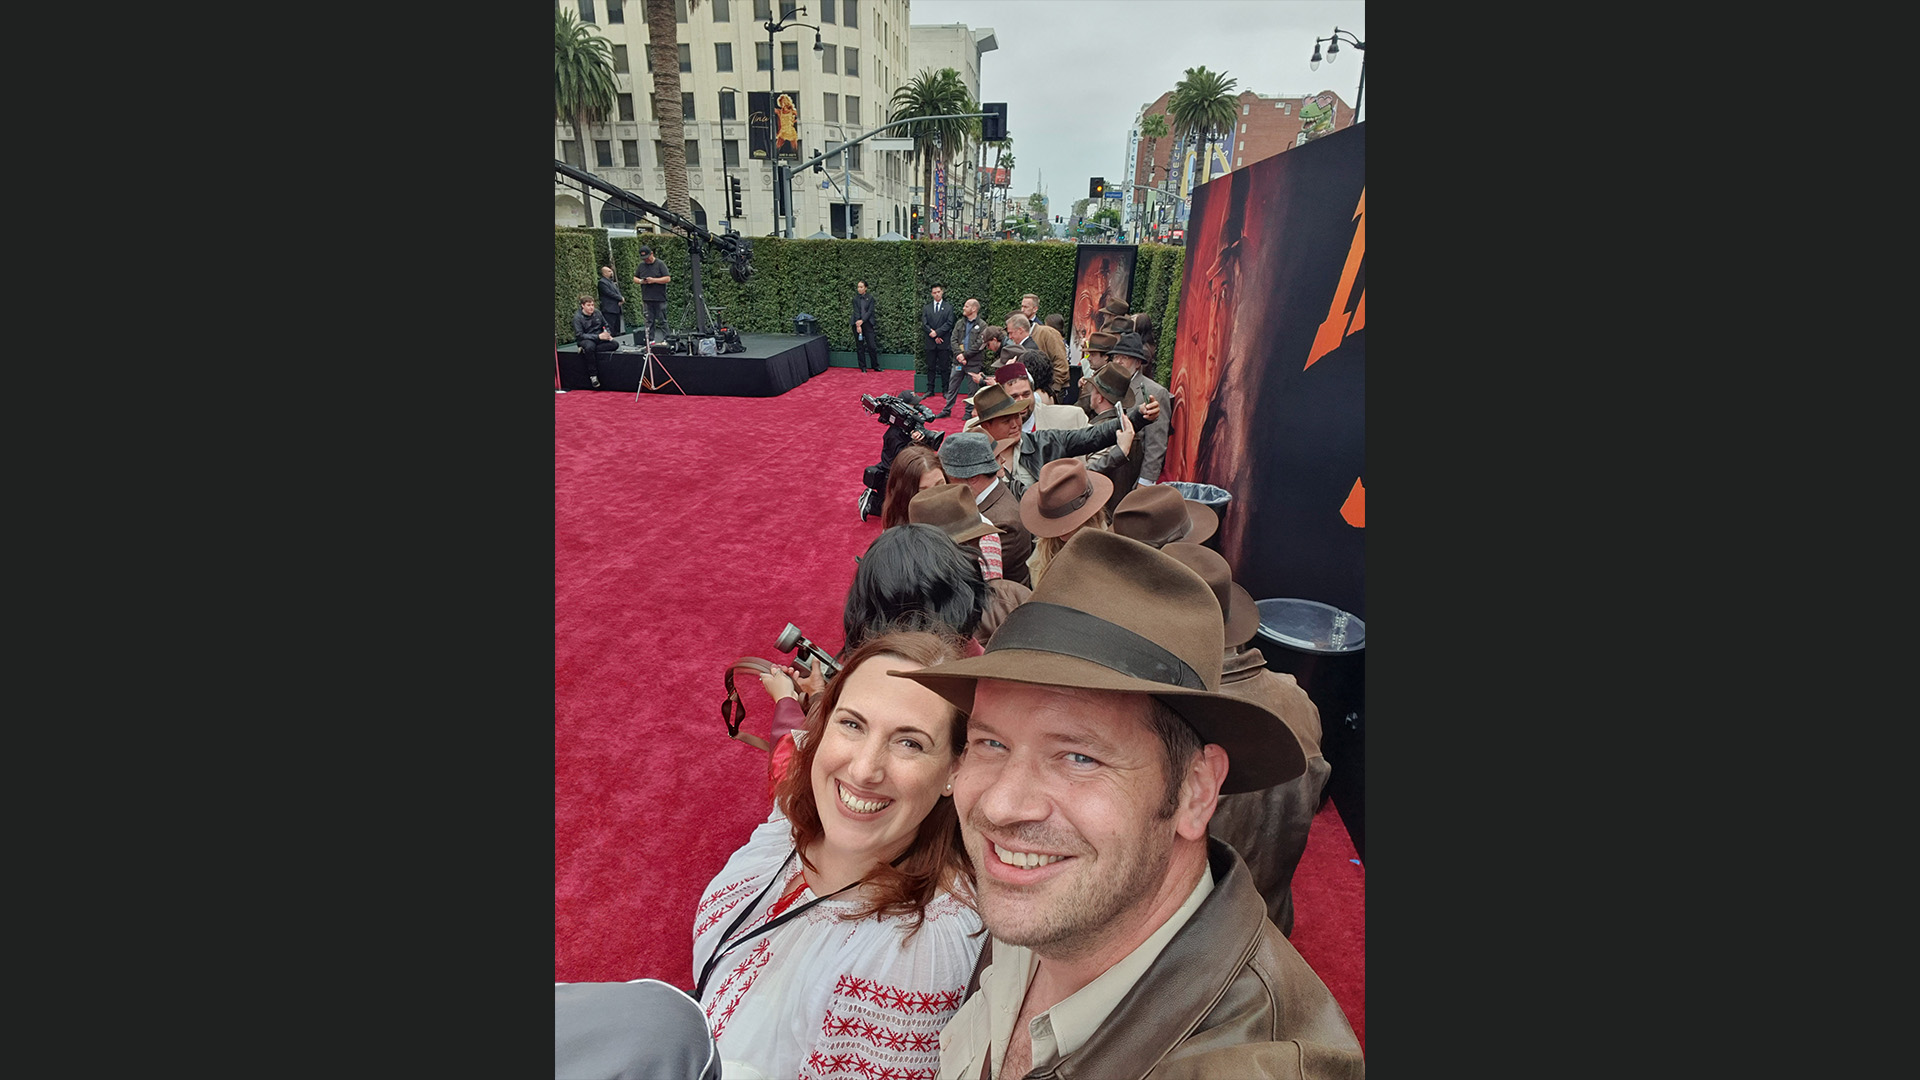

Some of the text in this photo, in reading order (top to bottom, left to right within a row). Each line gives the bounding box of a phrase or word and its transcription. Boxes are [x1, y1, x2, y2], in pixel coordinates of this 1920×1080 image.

[749, 111, 769, 124] Tina
[937, 162, 945, 183] WAX
[1126, 130, 1138, 217] SCIENTOOGY
